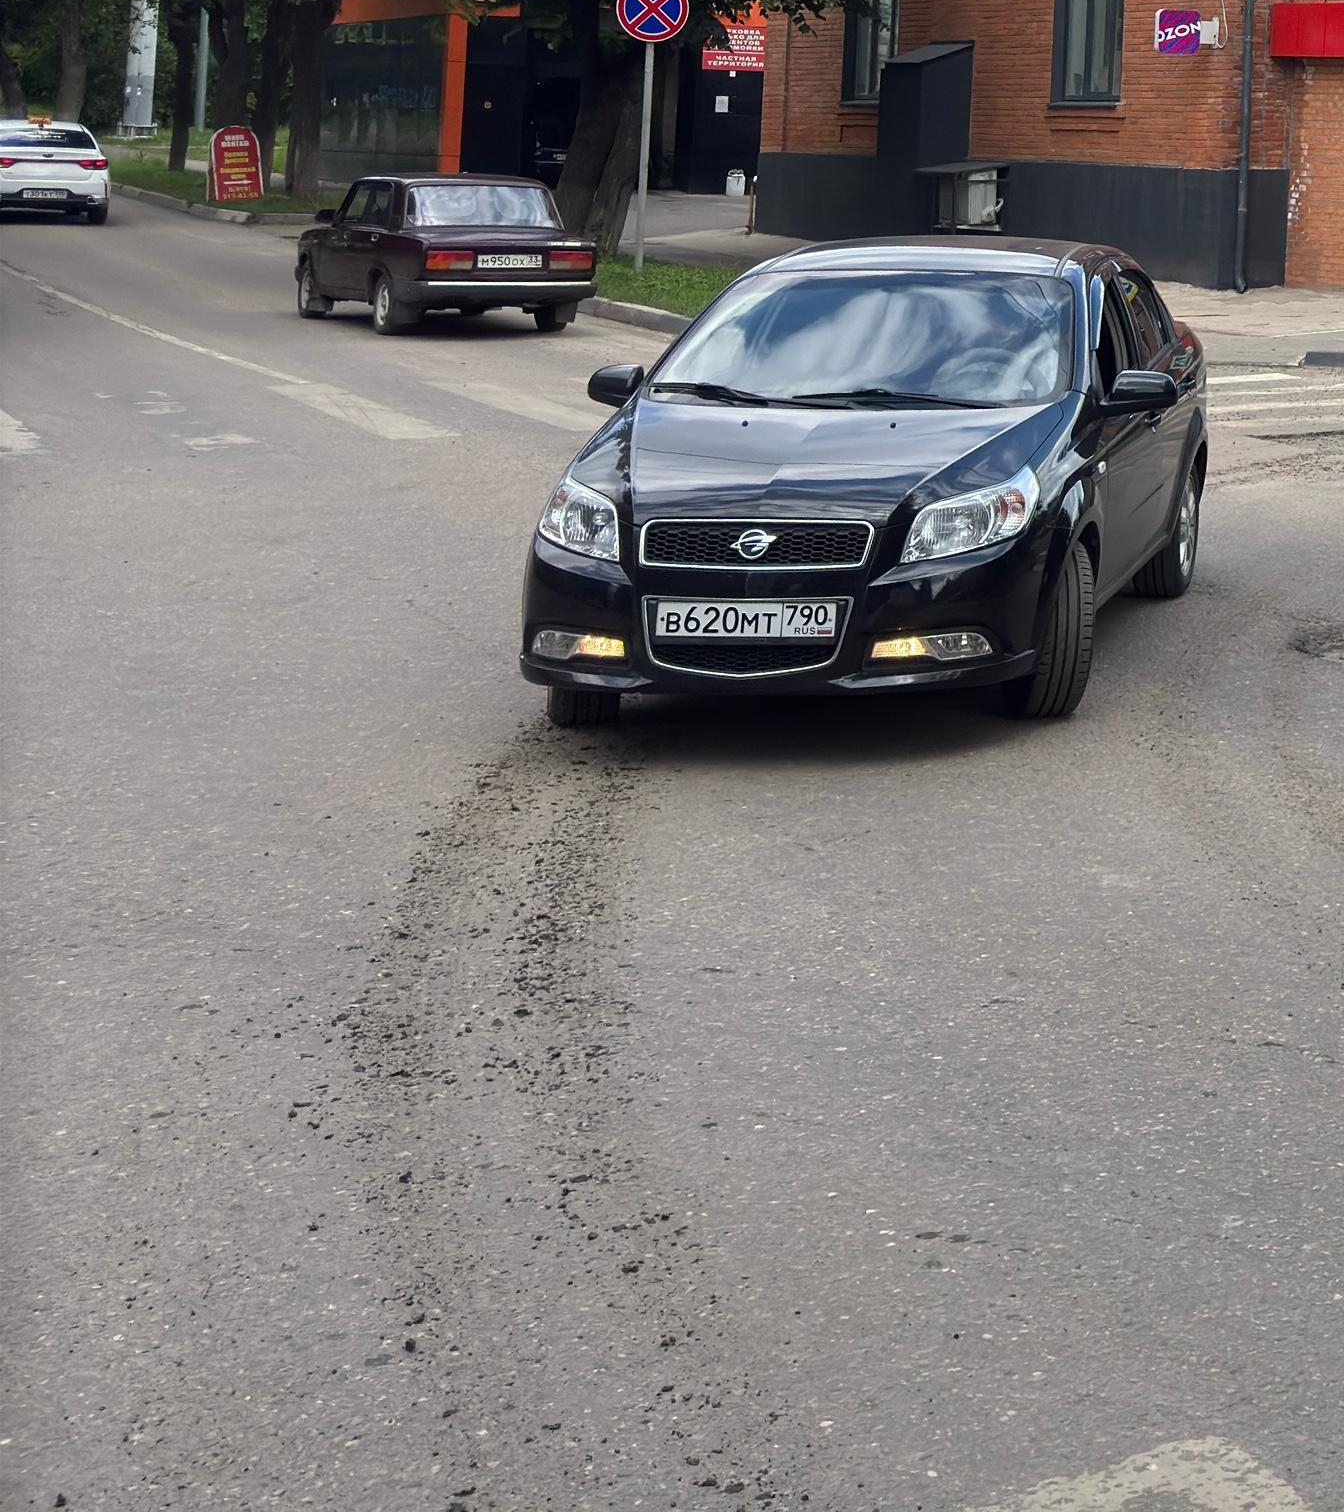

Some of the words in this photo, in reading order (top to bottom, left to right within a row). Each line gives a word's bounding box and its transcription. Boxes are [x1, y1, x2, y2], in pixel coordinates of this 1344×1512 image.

[1158, 21, 1200, 43] OZON
[707, 60, 765, 68] ТЕРРИТОРИЯ
[481, 256, 525, 266] М950ОХ
[528, 255, 538, 263] 33
[665, 606, 778, 634] В620МТ
[785, 605, 829, 626] 790
[794, 627, 816, 635] RUS
